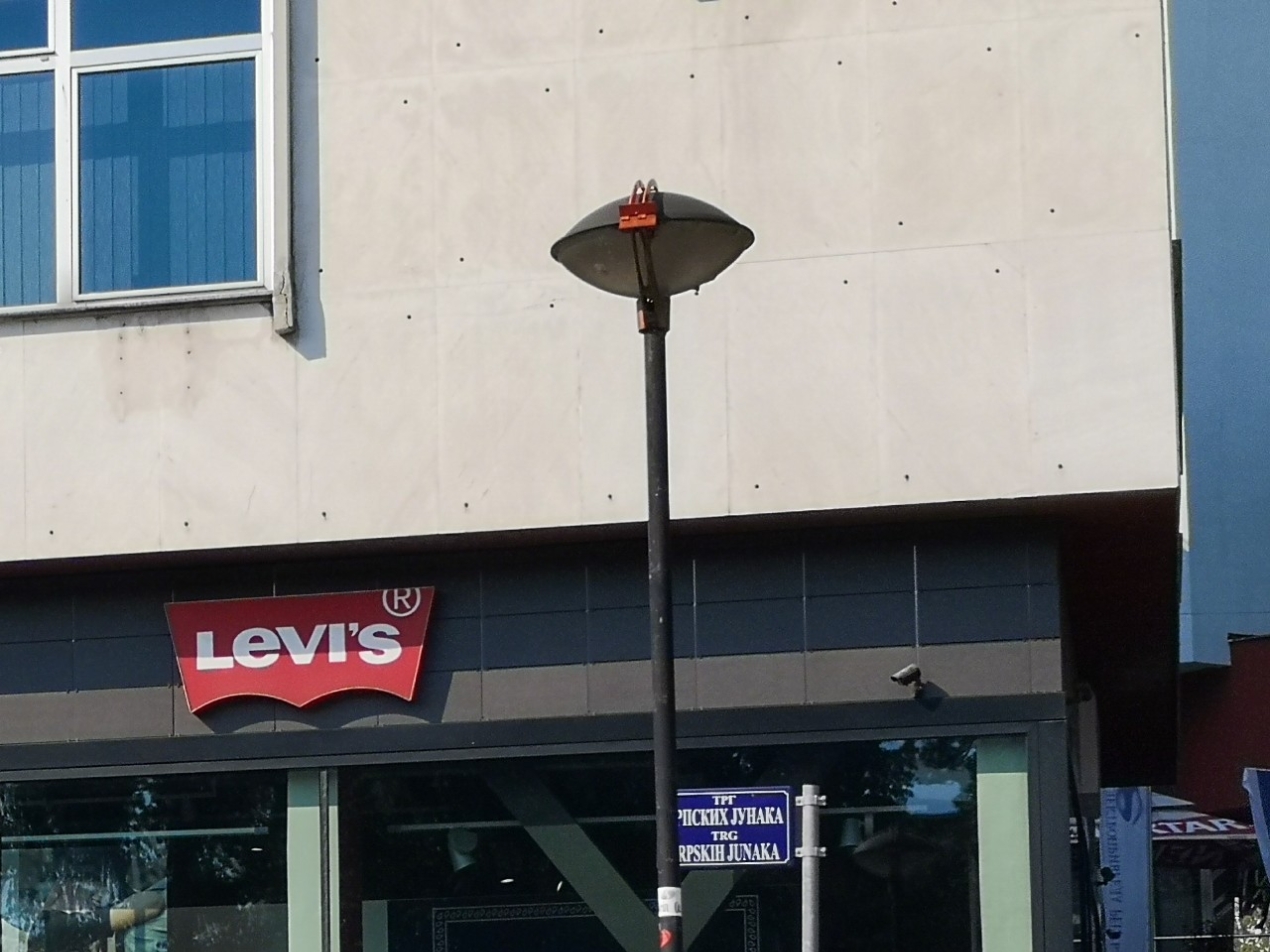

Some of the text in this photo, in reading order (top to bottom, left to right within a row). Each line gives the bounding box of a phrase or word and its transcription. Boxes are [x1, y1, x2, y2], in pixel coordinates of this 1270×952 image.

[711, 795, 737, 806] ТРГ
[730, 806, 784, 825] ЈУНАКА
[710, 831, 738, 841] TRG
[726, 842, 781, 861] JUNAKA
